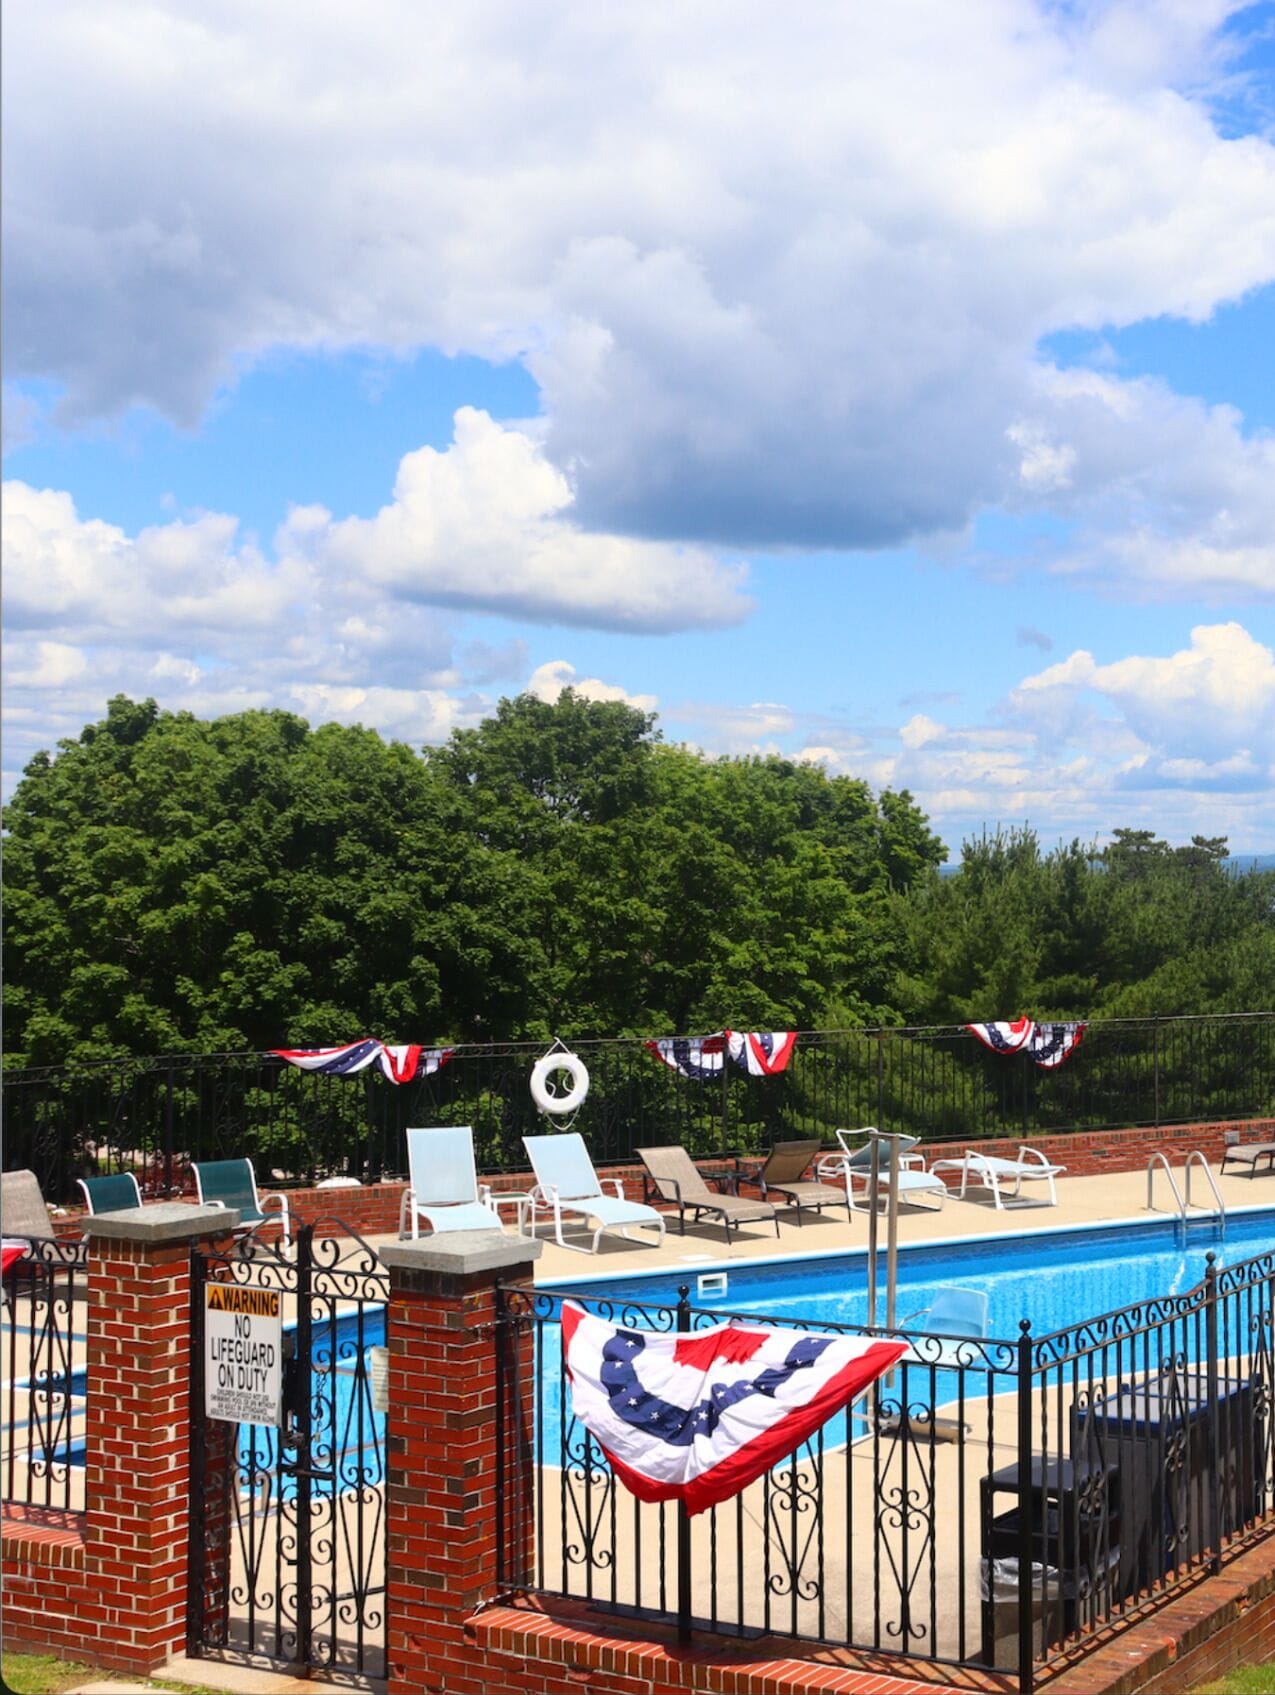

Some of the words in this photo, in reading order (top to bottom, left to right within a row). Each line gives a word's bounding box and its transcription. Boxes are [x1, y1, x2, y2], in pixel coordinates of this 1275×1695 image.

[223, 1287, 279, 1317] WARNING
[234, 1314, 251, 1338] NO
[212, 1337, 274, 1368] LIFEGUARD
[218, 1363, 234, 1388] ON
[238, 1366, 268, 1392] DUTY
